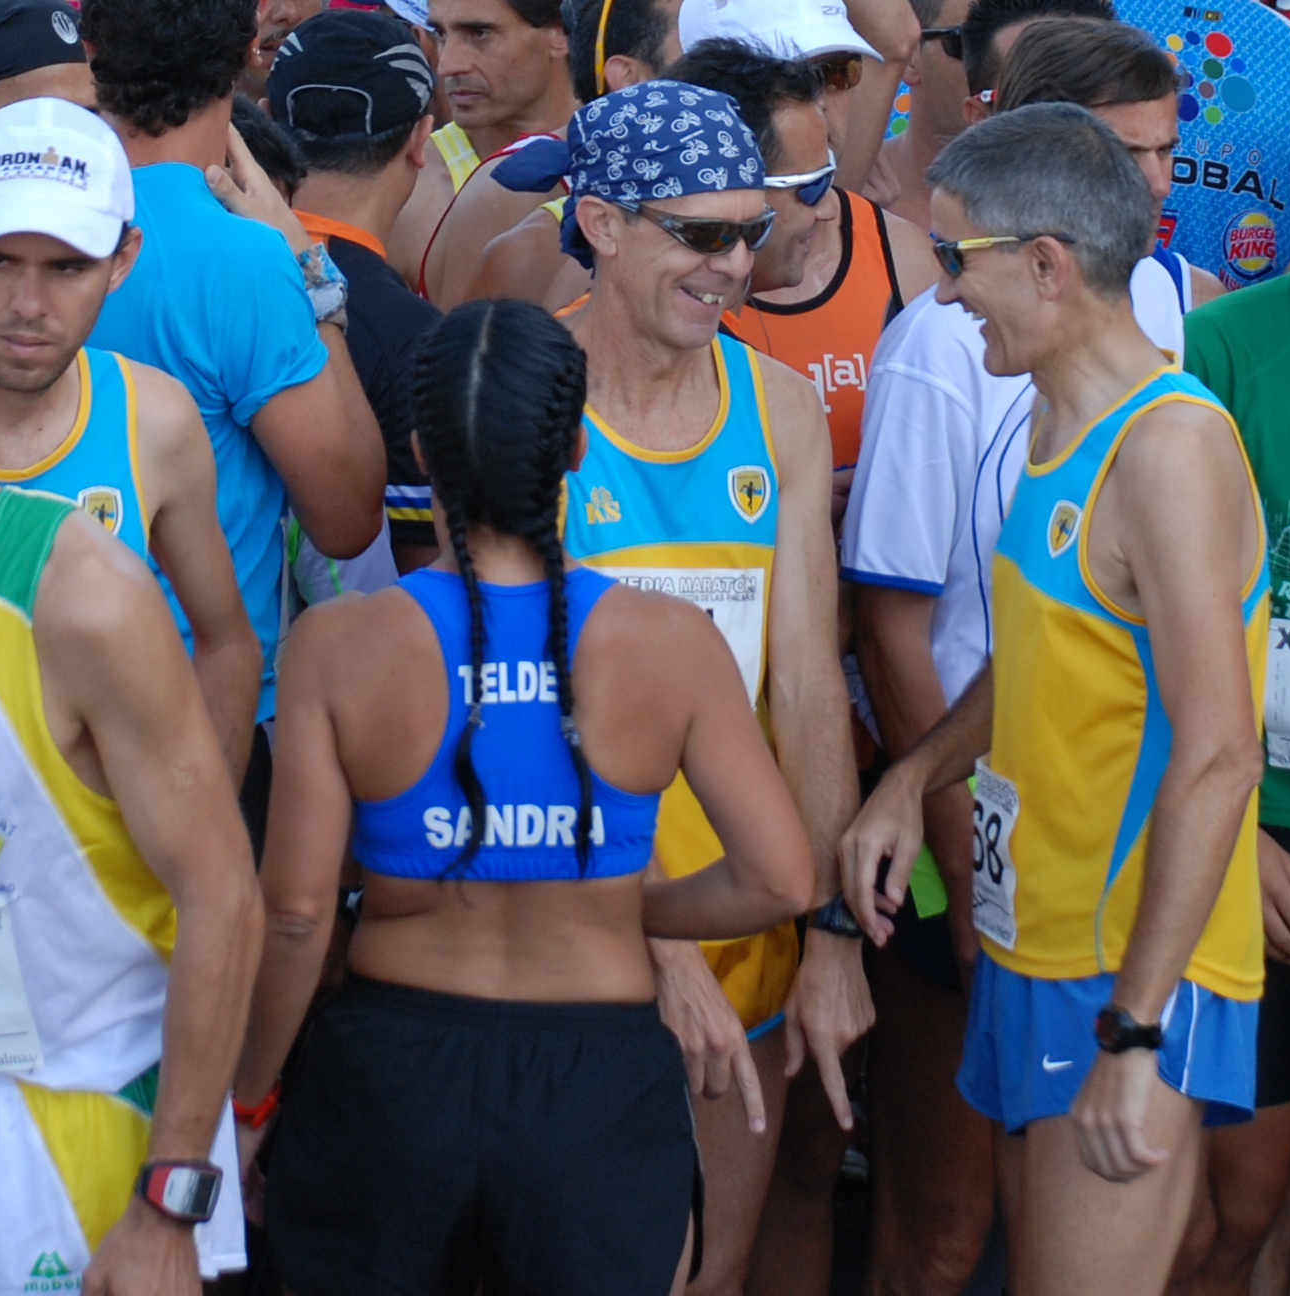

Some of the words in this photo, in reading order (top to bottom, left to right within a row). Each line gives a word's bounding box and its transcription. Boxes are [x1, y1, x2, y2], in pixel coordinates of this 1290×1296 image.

[1176, 139, 1263, 165] UPO
[1171, 156, 1285, 211] OBAL
[1229, 240, 1277, 260] KING
[679, 573, 757, 593] MARATÓN
[458, 661, 559, 705] TELDE
[422, 803, 606, 849] SANDRA
[23, 1277, 82, 1293] mobel
